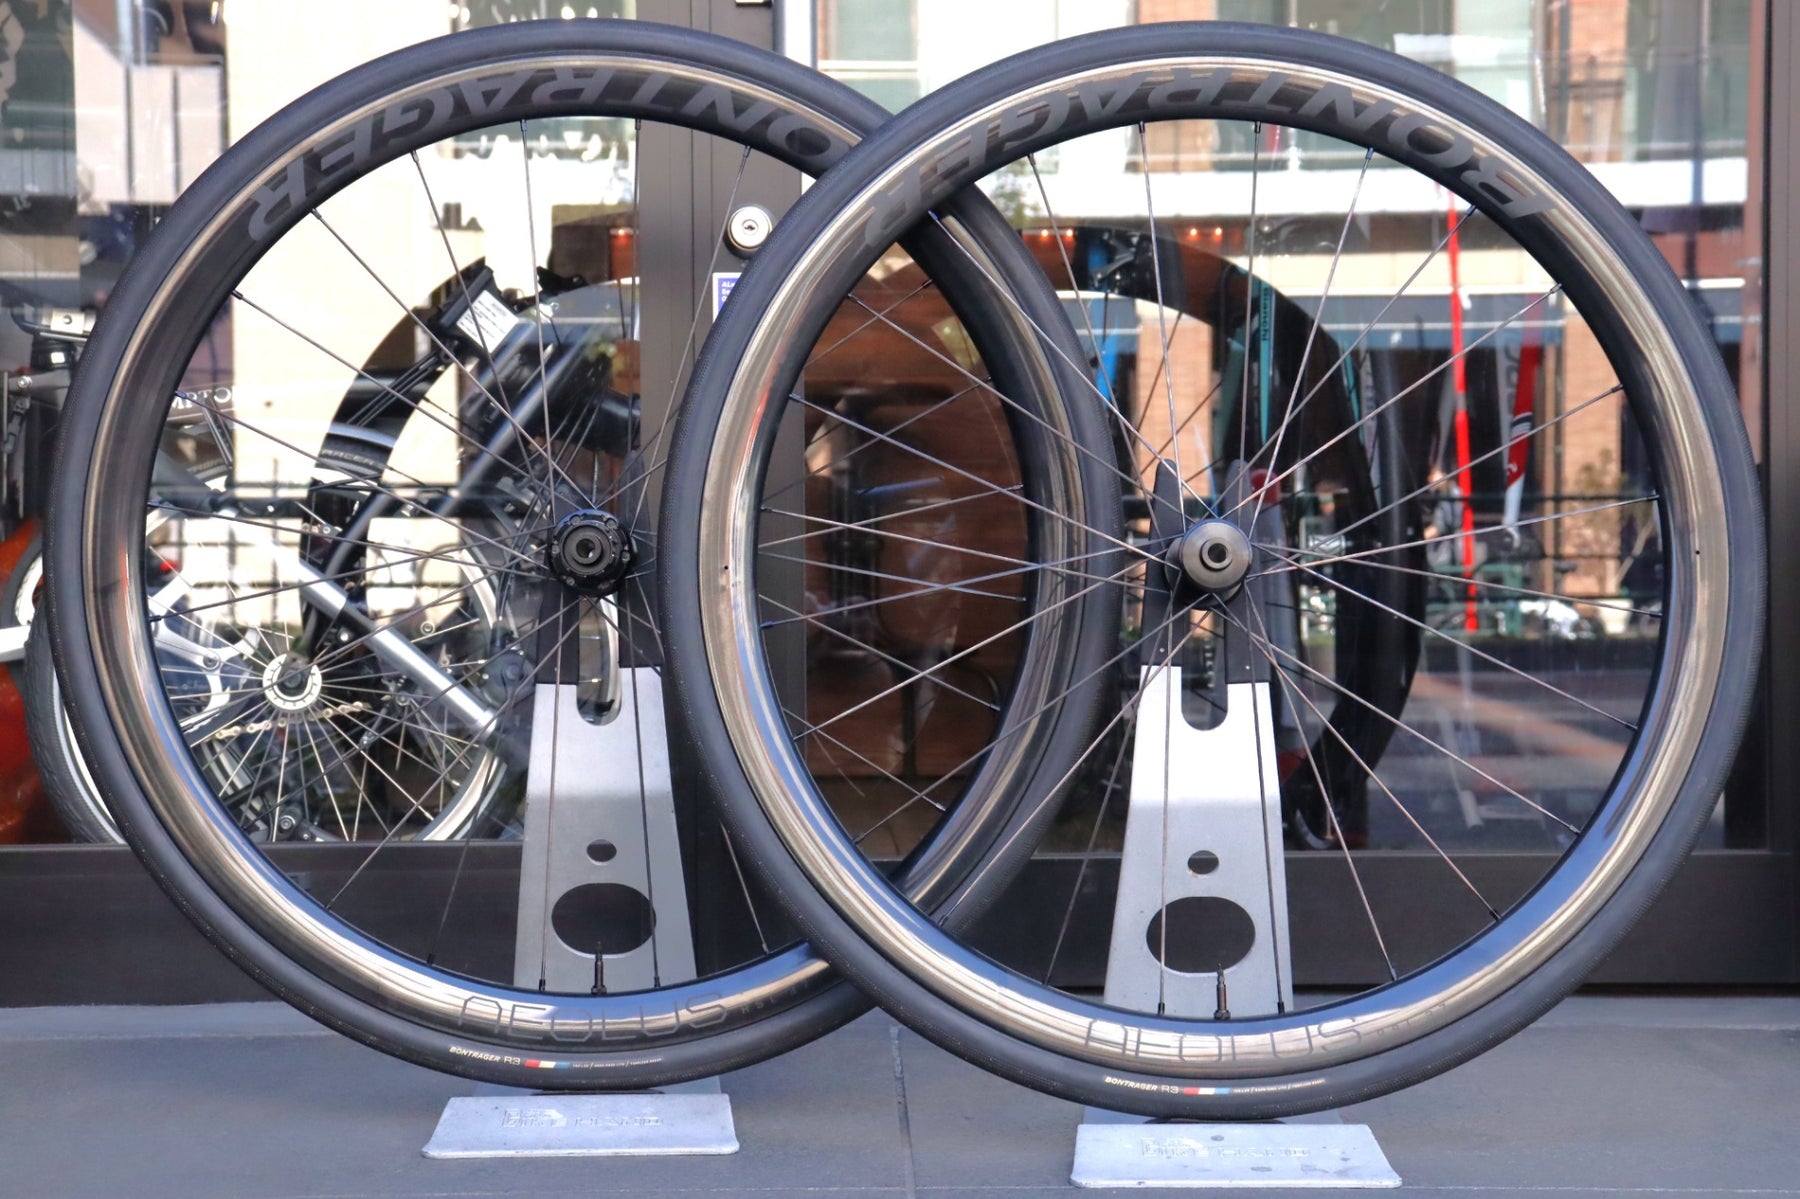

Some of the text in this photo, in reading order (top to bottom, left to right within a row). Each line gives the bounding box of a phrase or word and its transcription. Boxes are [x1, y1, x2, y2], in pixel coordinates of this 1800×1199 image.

[247, 66, 848, 242] ONTRAGER
[864, 66, 1556, 247] BONTRAGER
[457, 992, 728, 1042] AEOLUS
[449, 1045, 521, 1066] BONTRAGER R3
[1104, 1076, 1179, 1094] BONTRAGER R3
